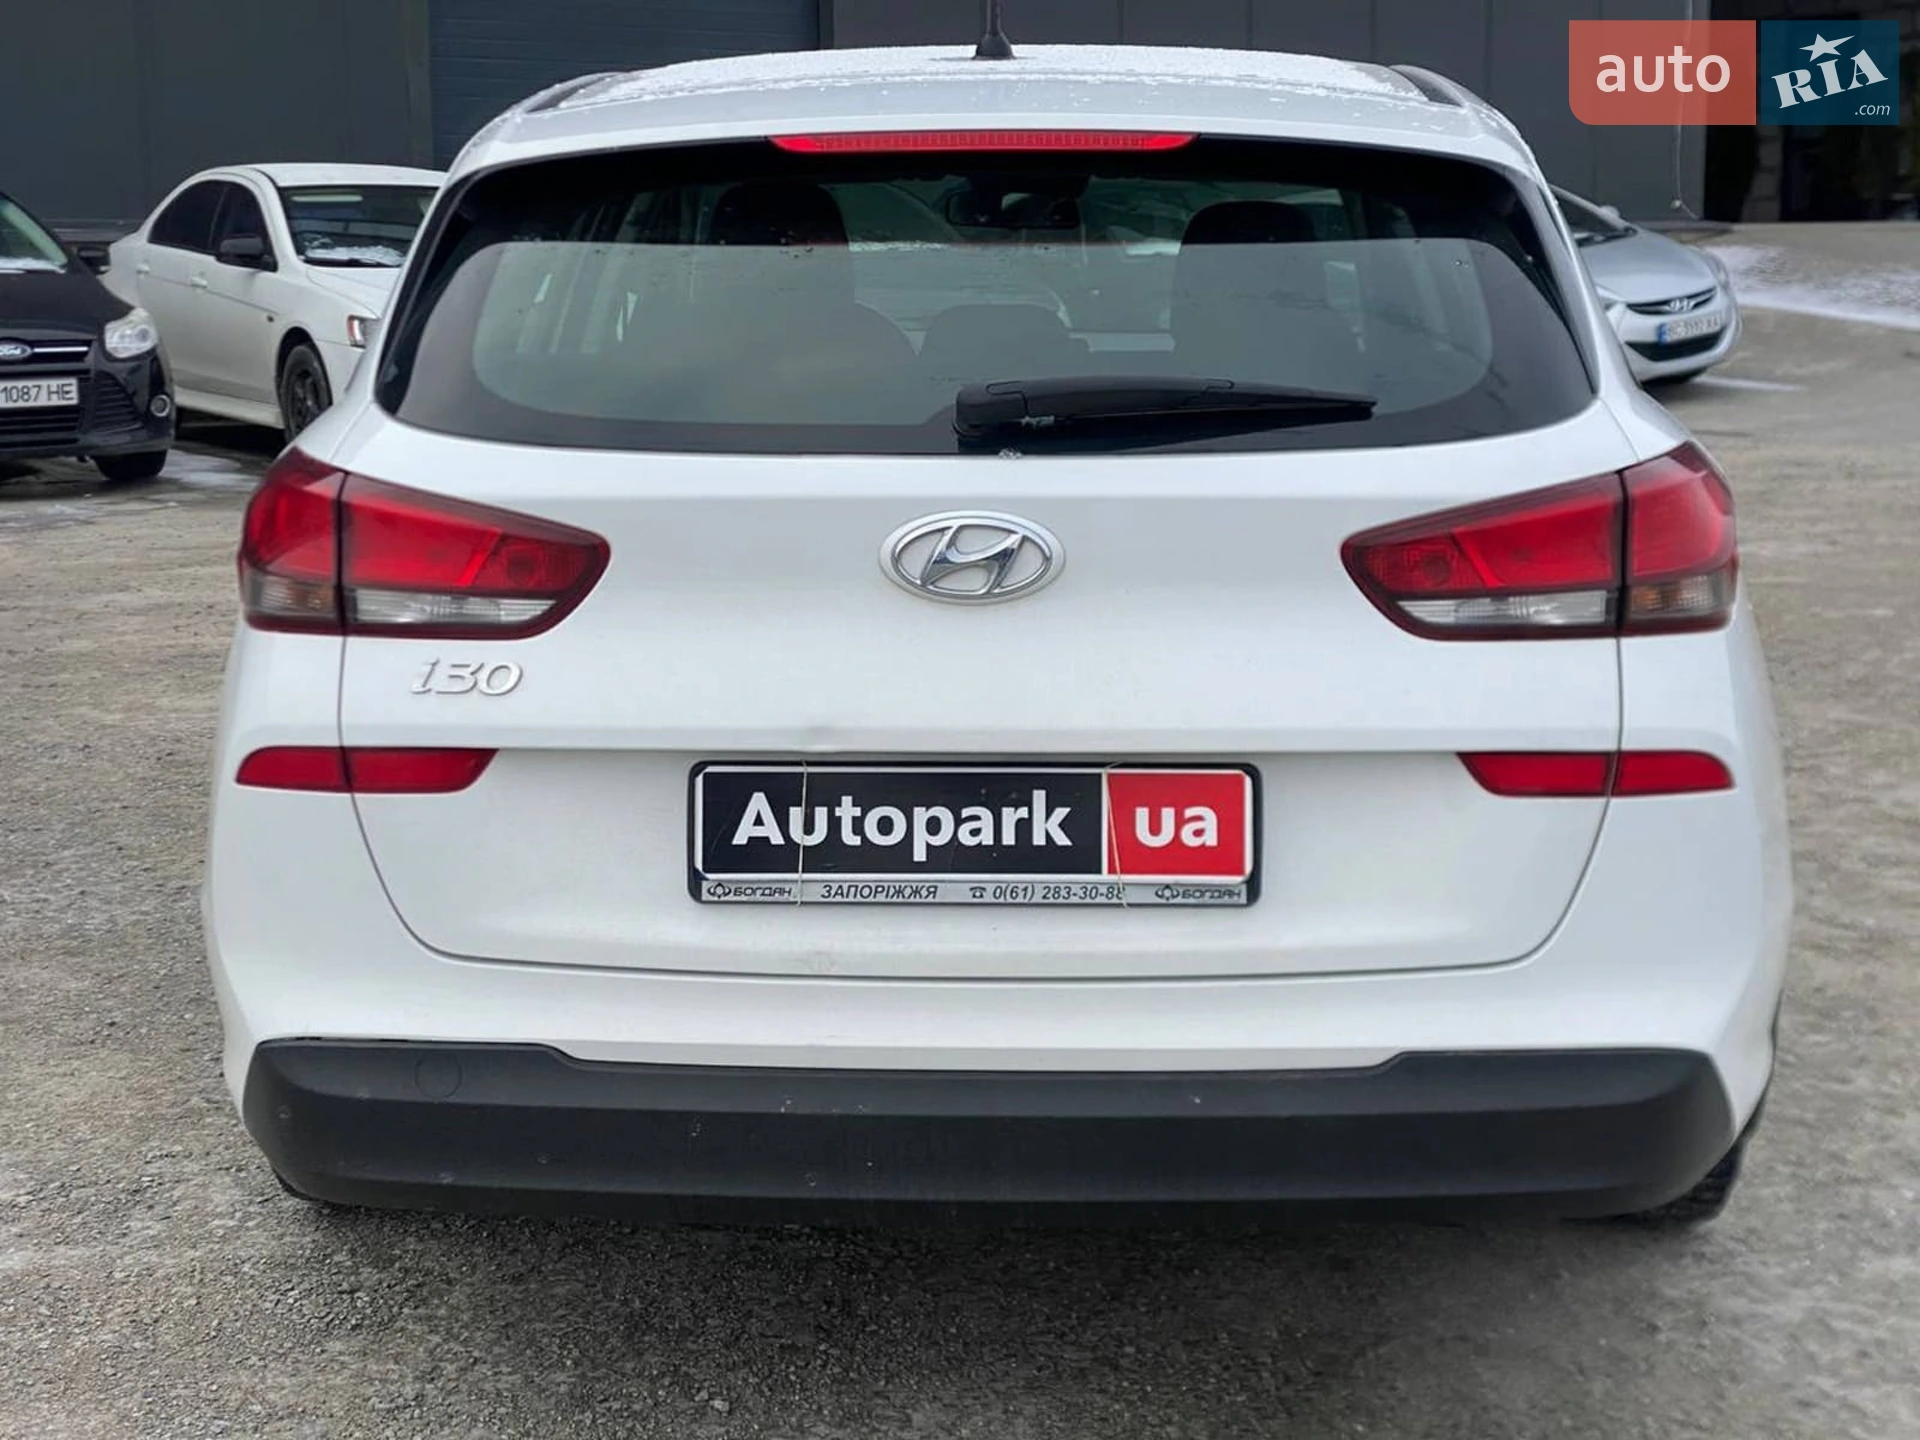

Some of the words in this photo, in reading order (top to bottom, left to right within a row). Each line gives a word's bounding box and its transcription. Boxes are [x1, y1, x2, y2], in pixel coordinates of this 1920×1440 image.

[0, 384, 41, 403] 1087
[47, 383, 74, 401] HE
[410, 657, 524, 696] i30
[731, 789, 1073, 862] Autopark
[1135, 806, 1219, 848] ua
[733, 886, 792, 898] БОГДАН
[820, 884, 938, 900] ЗАПОРІЖЖЯ
[992, 885, 1035, 901] 0(61)
